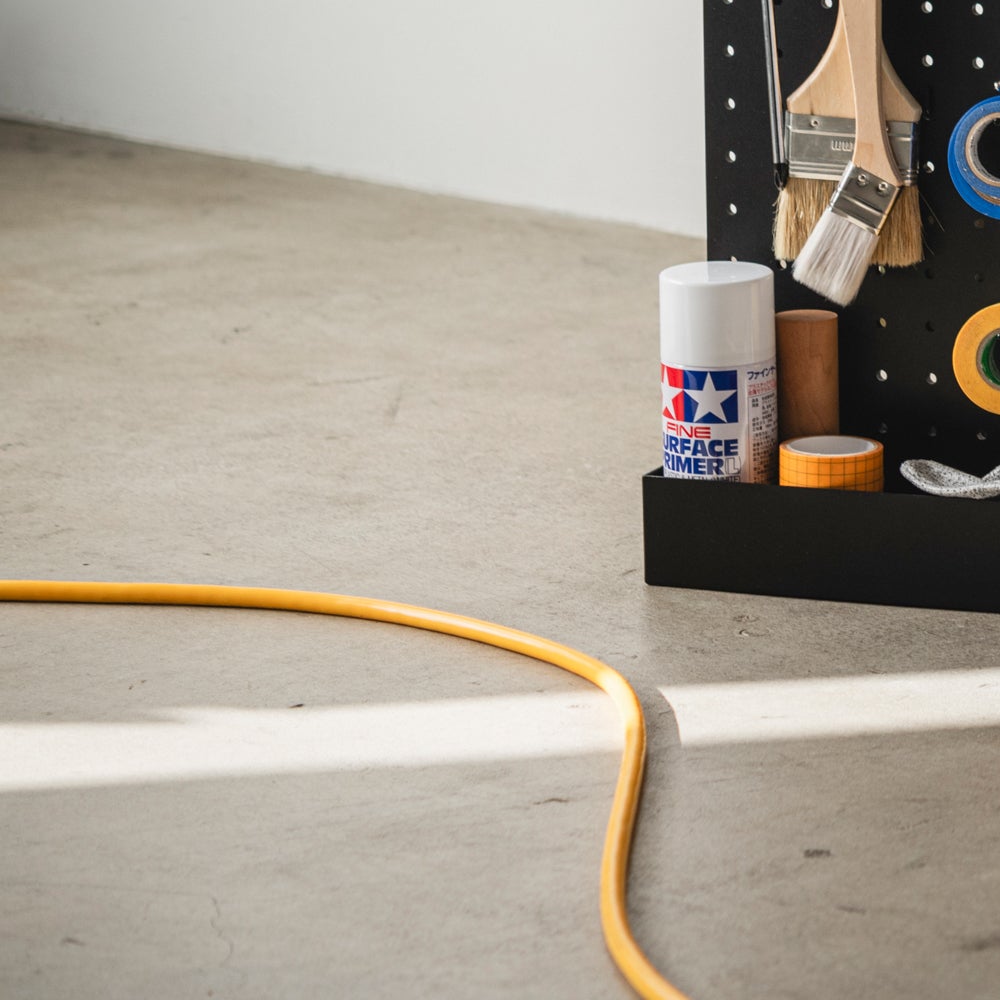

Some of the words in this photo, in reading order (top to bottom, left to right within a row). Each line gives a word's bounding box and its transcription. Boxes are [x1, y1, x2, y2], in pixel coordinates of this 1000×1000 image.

[667, 422, 711, 439] FINE
[663, 433, 739, 457] URFACE
[664, 454, 724, 475] RIMER
